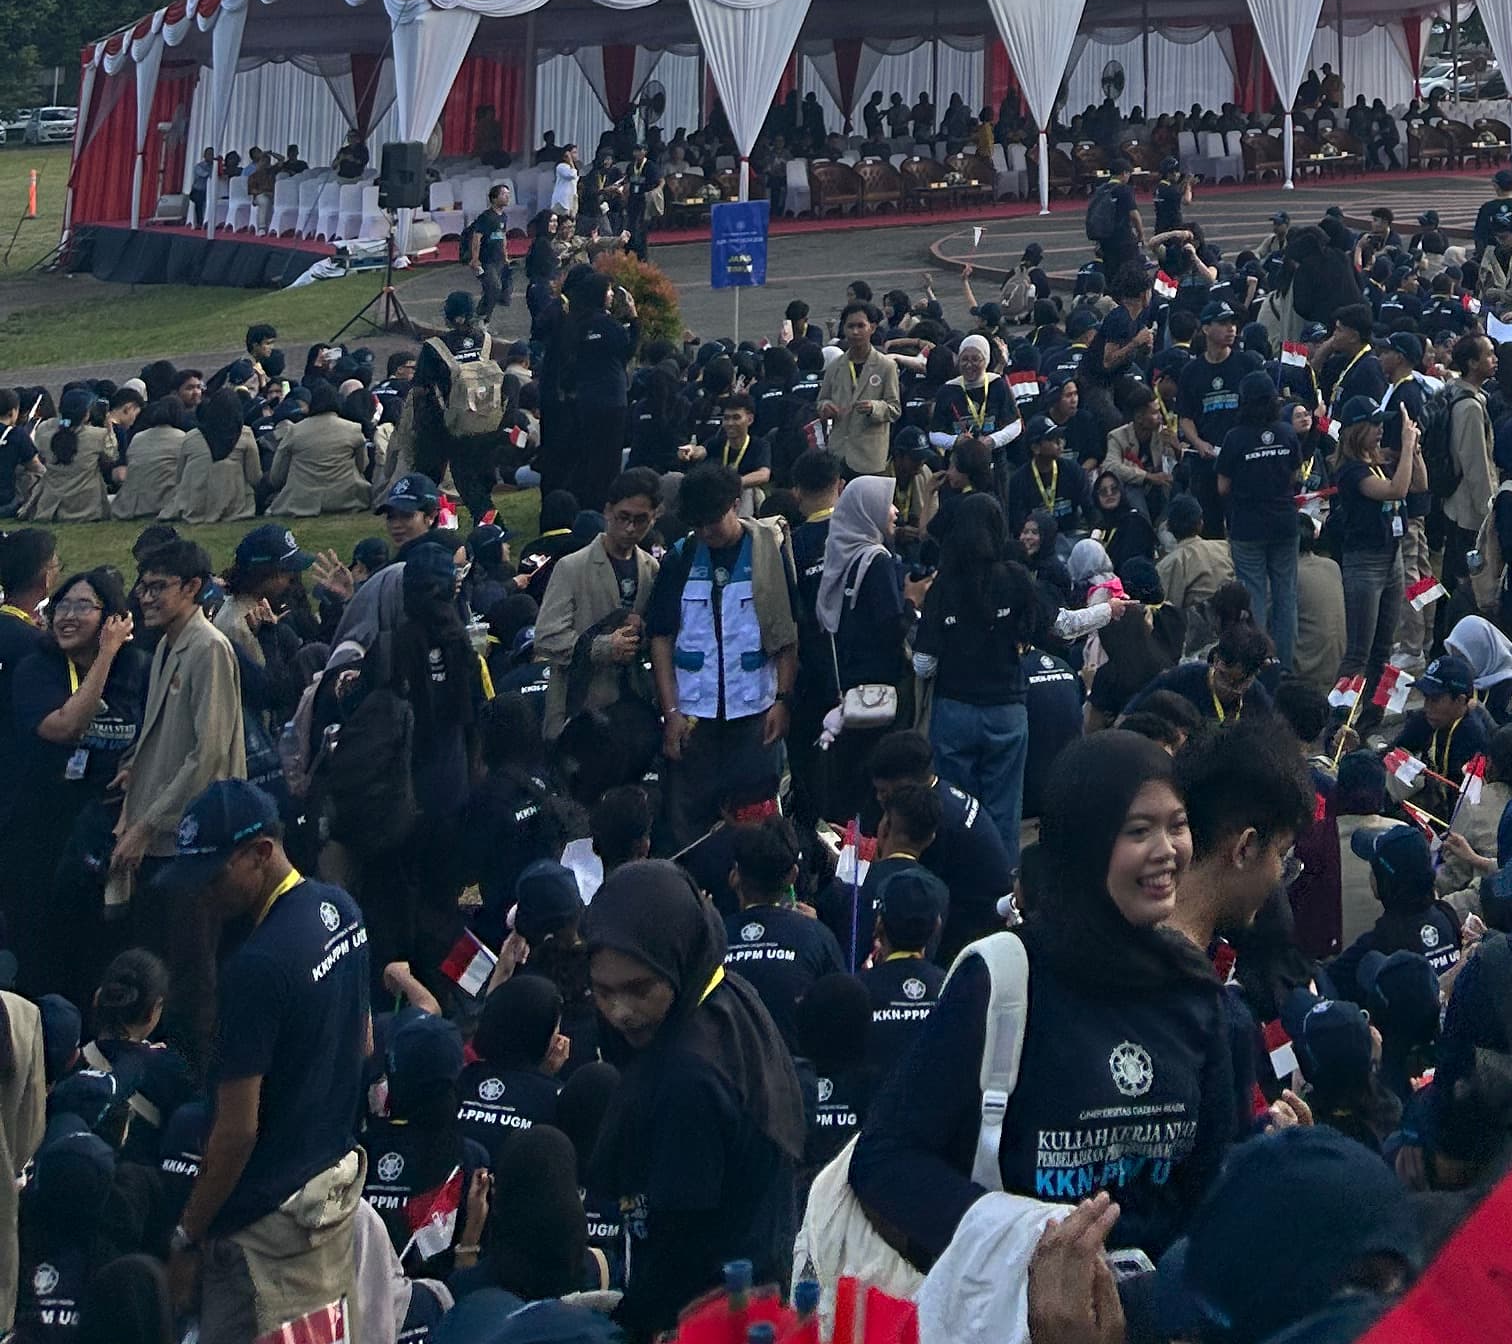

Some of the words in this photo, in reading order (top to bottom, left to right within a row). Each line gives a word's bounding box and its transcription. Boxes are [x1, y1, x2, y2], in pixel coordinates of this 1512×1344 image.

[766, 949, 797, 962] UGM
[499, 1114, 534, 1130] UGM
[1037, 1128, 1110, 1151] KULIAH
[1110, 1123, 1162, 1146] KERJA
[586, 1222, 620, 1238] UGM
